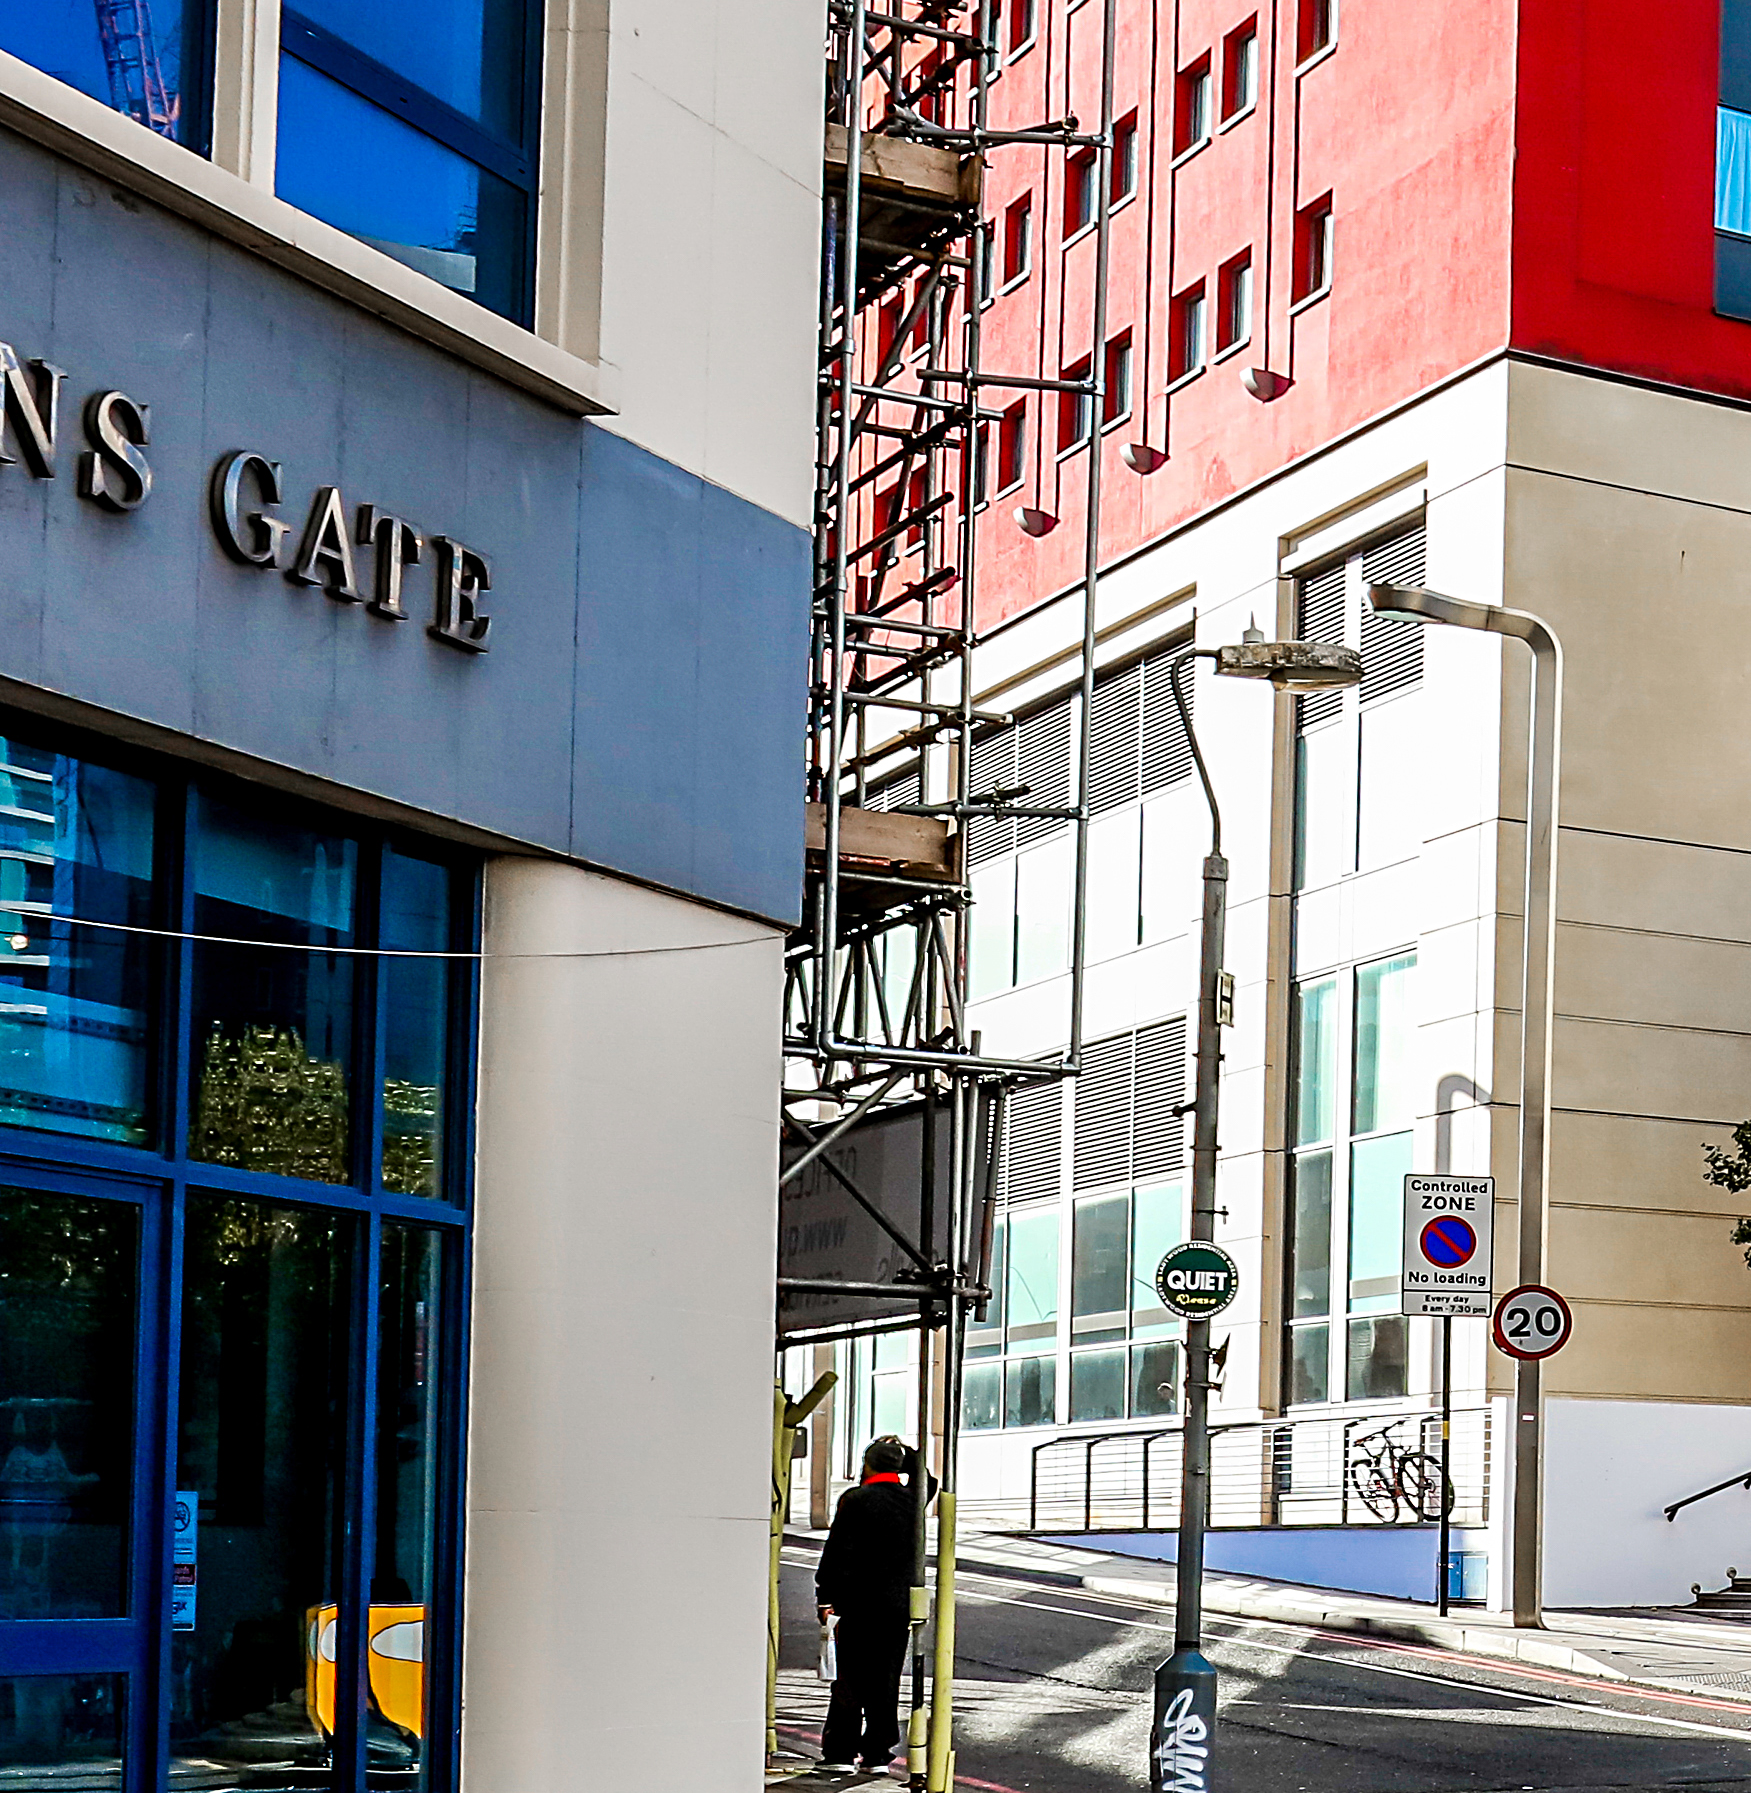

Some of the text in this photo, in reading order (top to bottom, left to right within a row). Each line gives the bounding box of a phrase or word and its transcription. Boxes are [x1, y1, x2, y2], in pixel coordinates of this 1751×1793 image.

[211, 448, 492, 654] GATE
[1411, 1179, 1488, 1194] Controlled
[1421, 1195, 1476, 1211] ZONE
[1167, 1270, 1228, 1291] QUIET
[1408, 1271, 1486, 1287] No loading
[1425, 1294, 1469, 1305] Every day
[1507, 1305, 1561, 1338] 20
